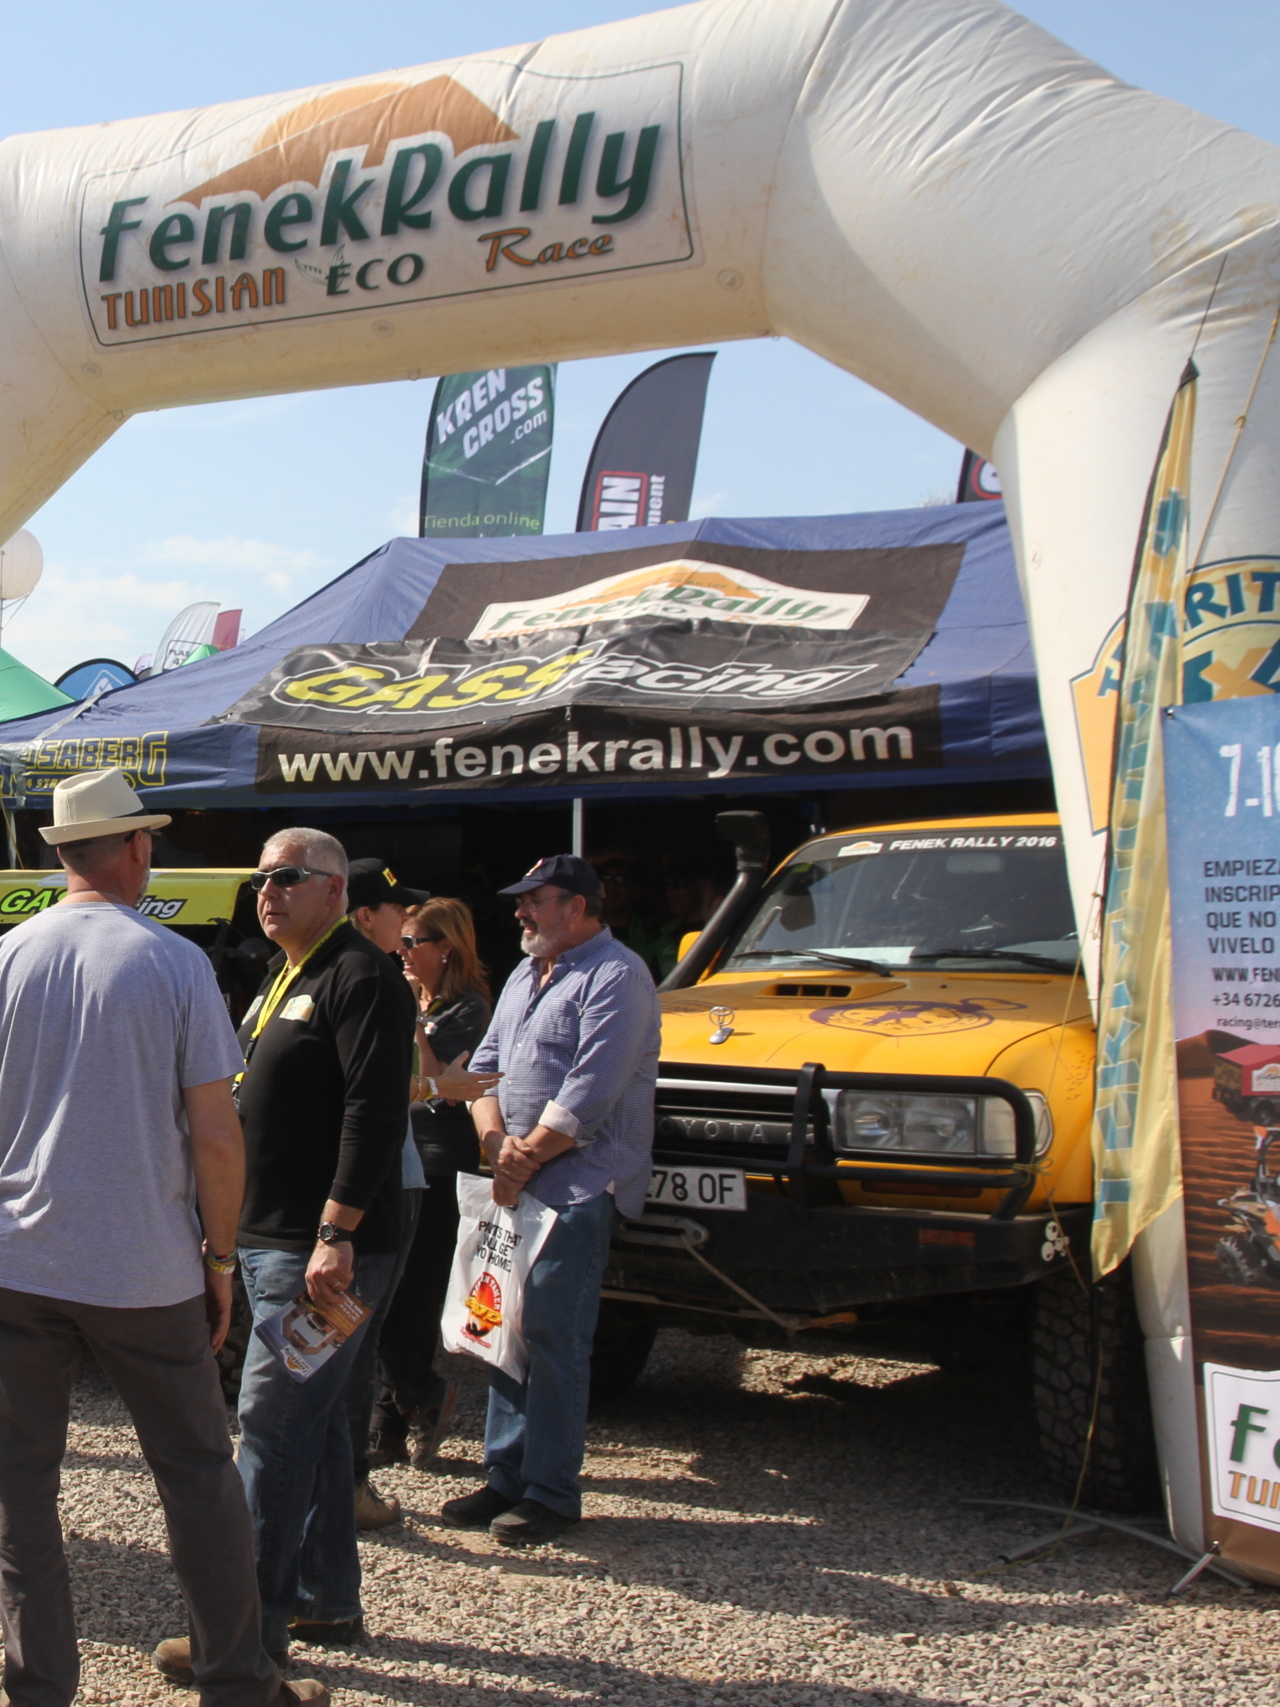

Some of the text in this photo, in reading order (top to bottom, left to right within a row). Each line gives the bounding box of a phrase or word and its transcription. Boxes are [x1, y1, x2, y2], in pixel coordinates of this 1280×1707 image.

[100, 226, 615, 330] TUNISIAN ECO Race
[436, 367, 506, 445] KREN
[462, 376, 545, 460] CROSS
[510, 408, 548, 445] .com
[423, 511, 540, 531] Tienda online
[278, 724, 915, 783] www.fenekrally.com
[889, 837, 949, 851] FENEK
[950, 836, 1014, 849] RALLY
[1015, 836, 1057, 848] 2016
[1206, 911, 1277, 931] QUE NO
[1208, 936, 1275, 954] VIVELO
[1211, 992, 1280, 1008] +34 6726
[658, 1117, 768, 1143] OYOTA
[646, 1170, 737, 1205] 78 OF
